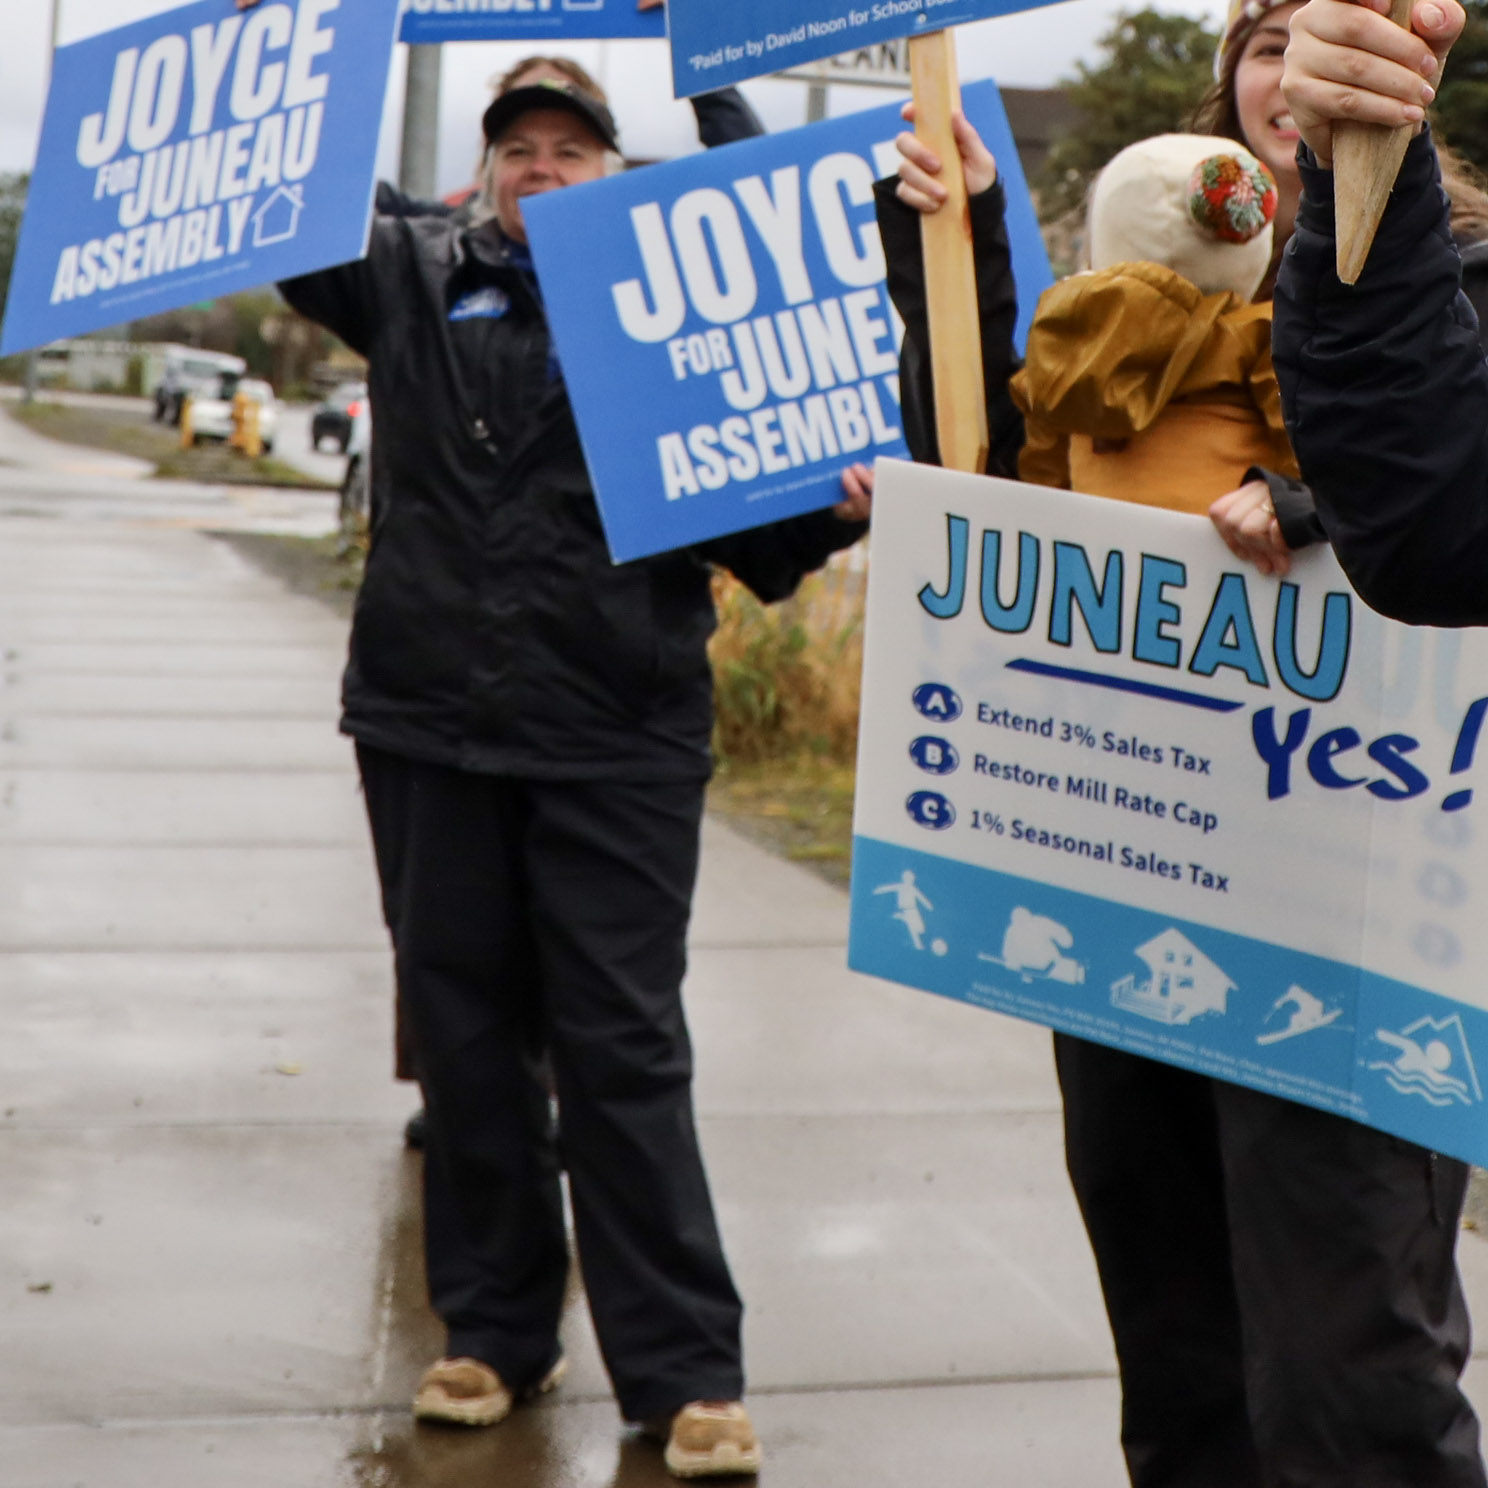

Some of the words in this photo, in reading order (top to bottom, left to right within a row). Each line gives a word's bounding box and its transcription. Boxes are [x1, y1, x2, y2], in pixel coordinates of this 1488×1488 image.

[725, 45, 744, 63] for
[746, 39, 763, 58] by
[766, 26, 806, 51] David
[808, 17, 846, 38] Noon
[848, 9, 870, 27] for
[93, 156, 138, 201] FOR
[118, 101, 324, 228] JUNEAU
[50, 194, 255, 305] ASSEMBLY
[611, 139, 900, 344] JOYC
[667, 327, 734, 382] FOR
[719, 287, 906, 411] JUNE
[656, 374, 902, 502] ASSEMBL
[917, 512, 1352, 703] JUNEAU
[973, 753, 1059, 792] Restore
[1066, 775, 1108, 804] Mill
[1113, 787, 1167, 818] Rate
[1173, 802, 1219, 835] Cap
[977, 702, 1054, 738] Extend
[1059, 721, 1096, 749] 3%
[1102, 731, 1164, 764] Sales
[1170, 746, 1212, 775] Tax
[970, 809, 1005, 836] 1%
[1010, 819, 1114, 863] Seasonal
[1120, 846, 1182, 881] Sales
[1188, 864, 1230, 893] Tax
